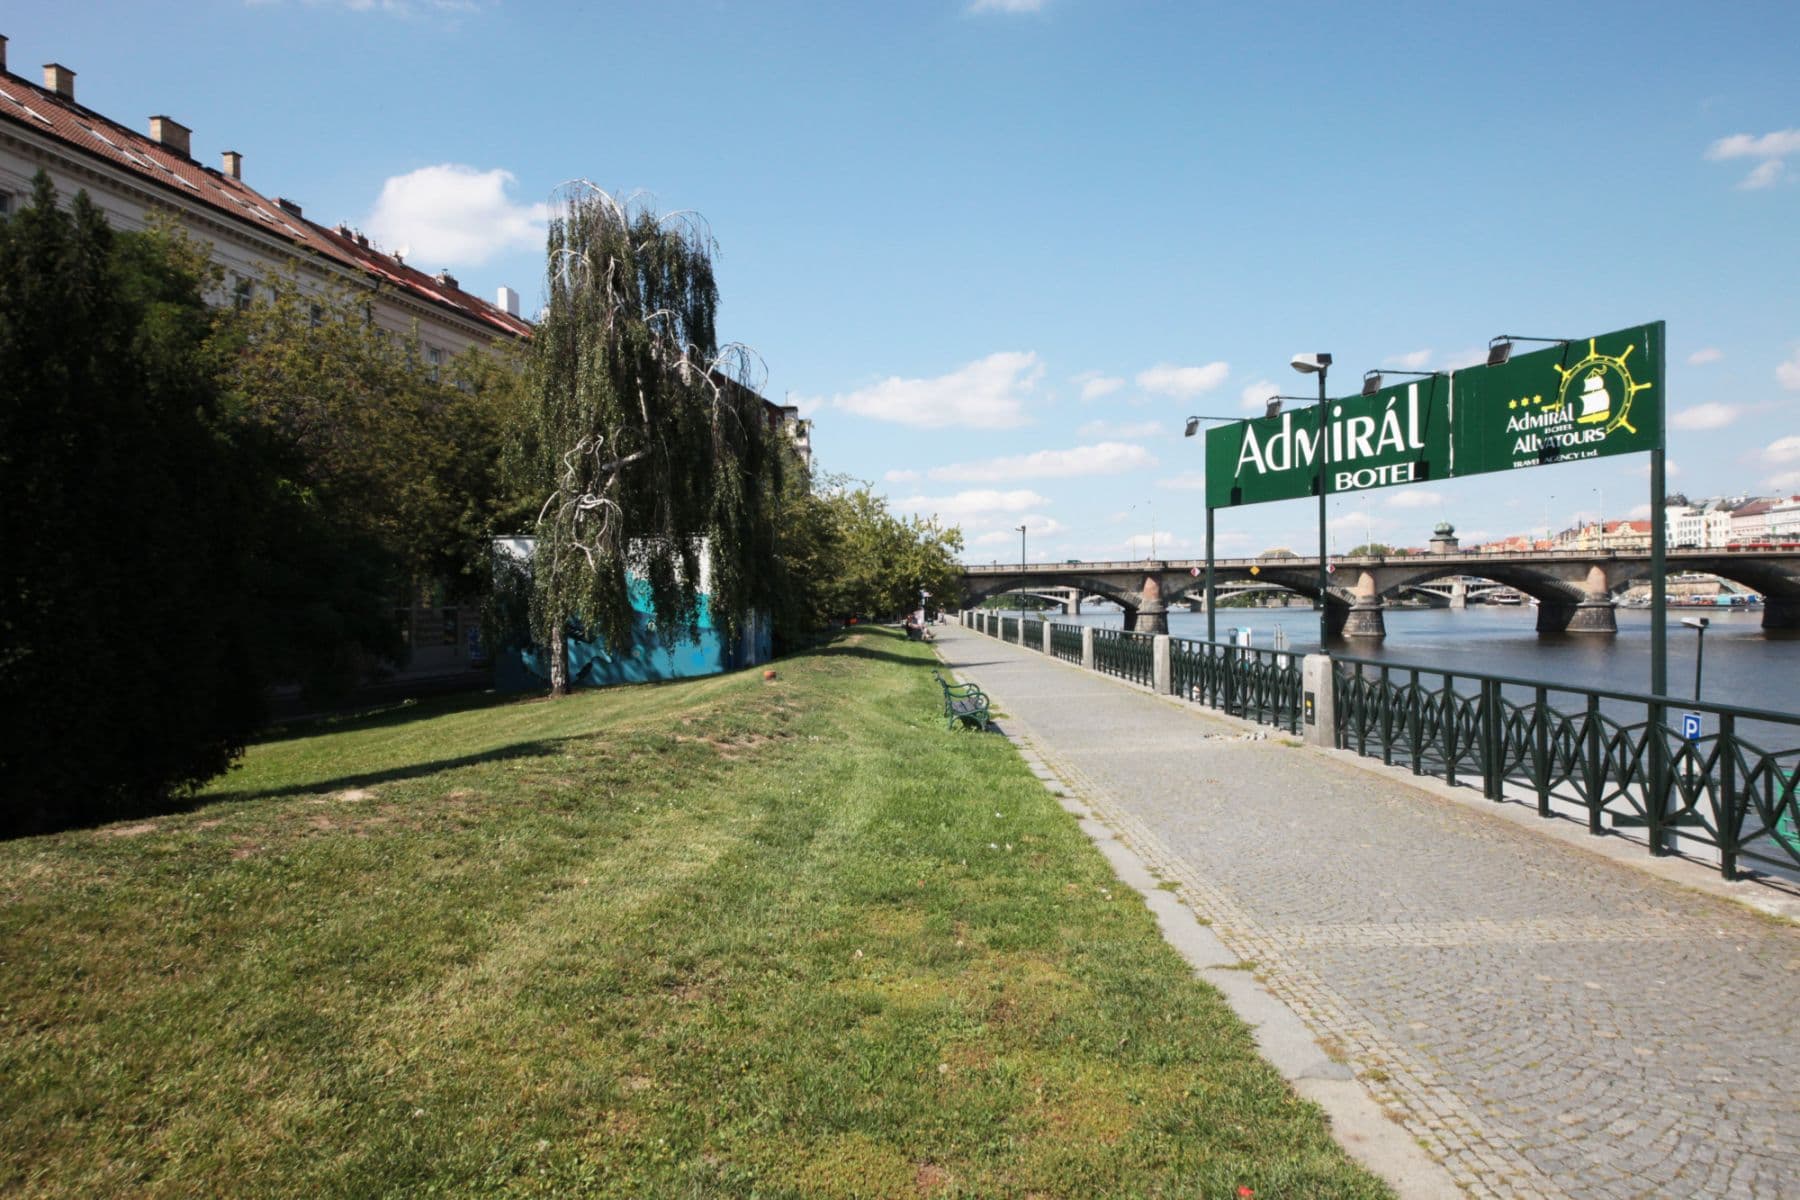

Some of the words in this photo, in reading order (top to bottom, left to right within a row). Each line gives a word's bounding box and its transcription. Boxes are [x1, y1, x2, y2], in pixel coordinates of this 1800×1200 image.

[1544, 423, 1573, 434] BOTEL
[1335, 462, 1422, 491] BOTEL
[1686, 718, 1698, 739] P
